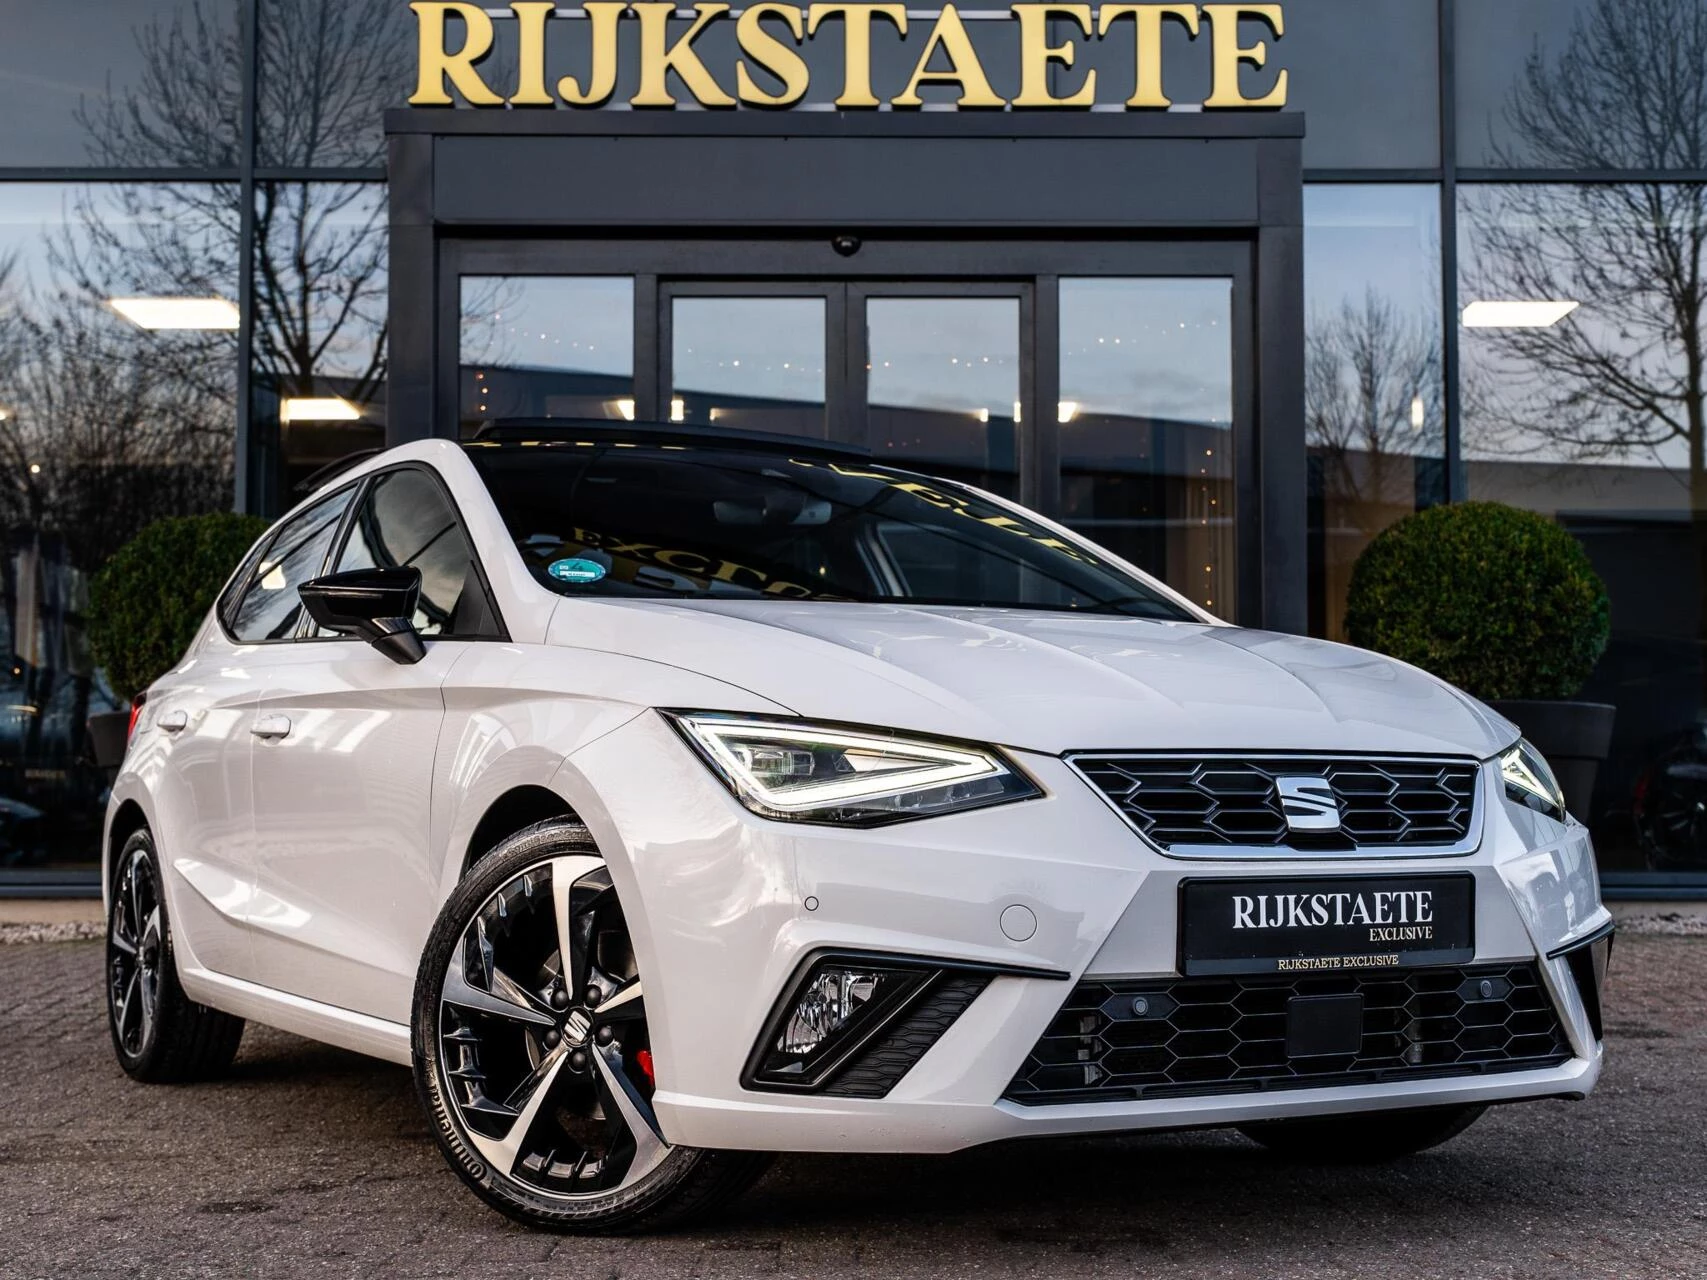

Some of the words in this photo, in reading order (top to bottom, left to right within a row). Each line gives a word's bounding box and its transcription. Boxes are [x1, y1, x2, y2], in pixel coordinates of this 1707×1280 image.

[408, 2, 1288, 108] RIJKSTAETE
[1232, 891, 1433, 929] RIJKSTAETE
[1369, 927, 1433, 942] EXCLUSIVE
[1277, 956, 1341, 971] RIJKSTAETE
[1343, 954, 1399, 968] EXCLUSIVE
